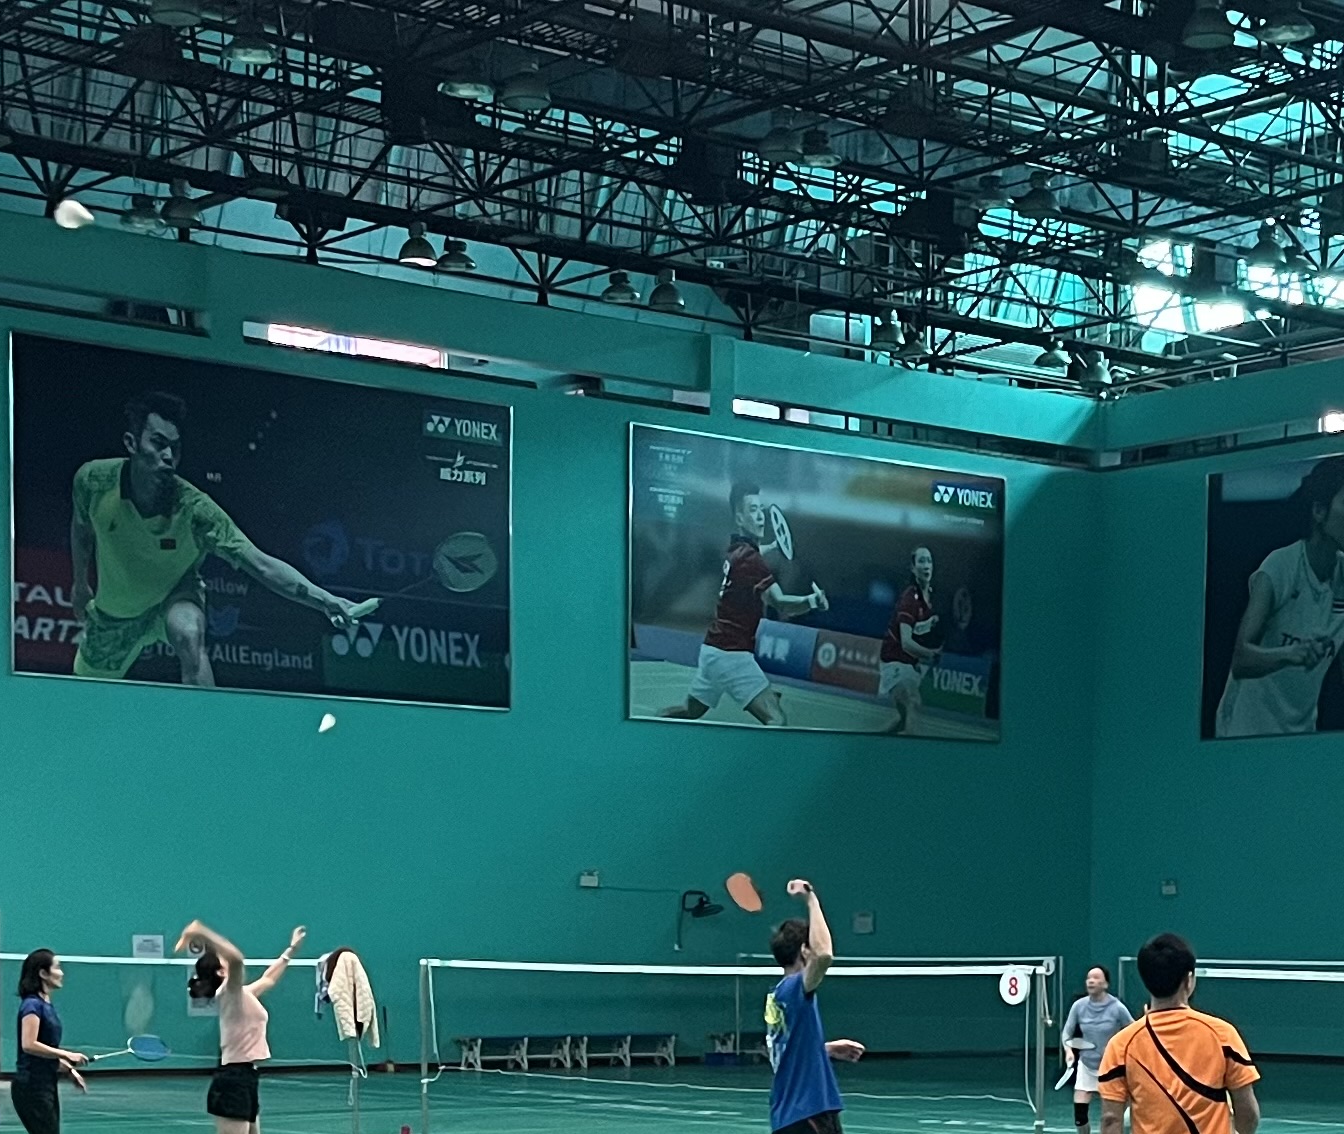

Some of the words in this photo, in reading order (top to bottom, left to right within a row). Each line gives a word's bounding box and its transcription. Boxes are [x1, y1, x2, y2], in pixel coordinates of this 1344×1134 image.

[454, 418, 497, 440] YONEX
[956, 487, 993, 509] YONEX
[206, 577, 249, 597] ollow
[390, 622, 483, 669] YONEX
[932, 666, 983, 697] YONEX
[1008, 976, 1019, 997] 8
